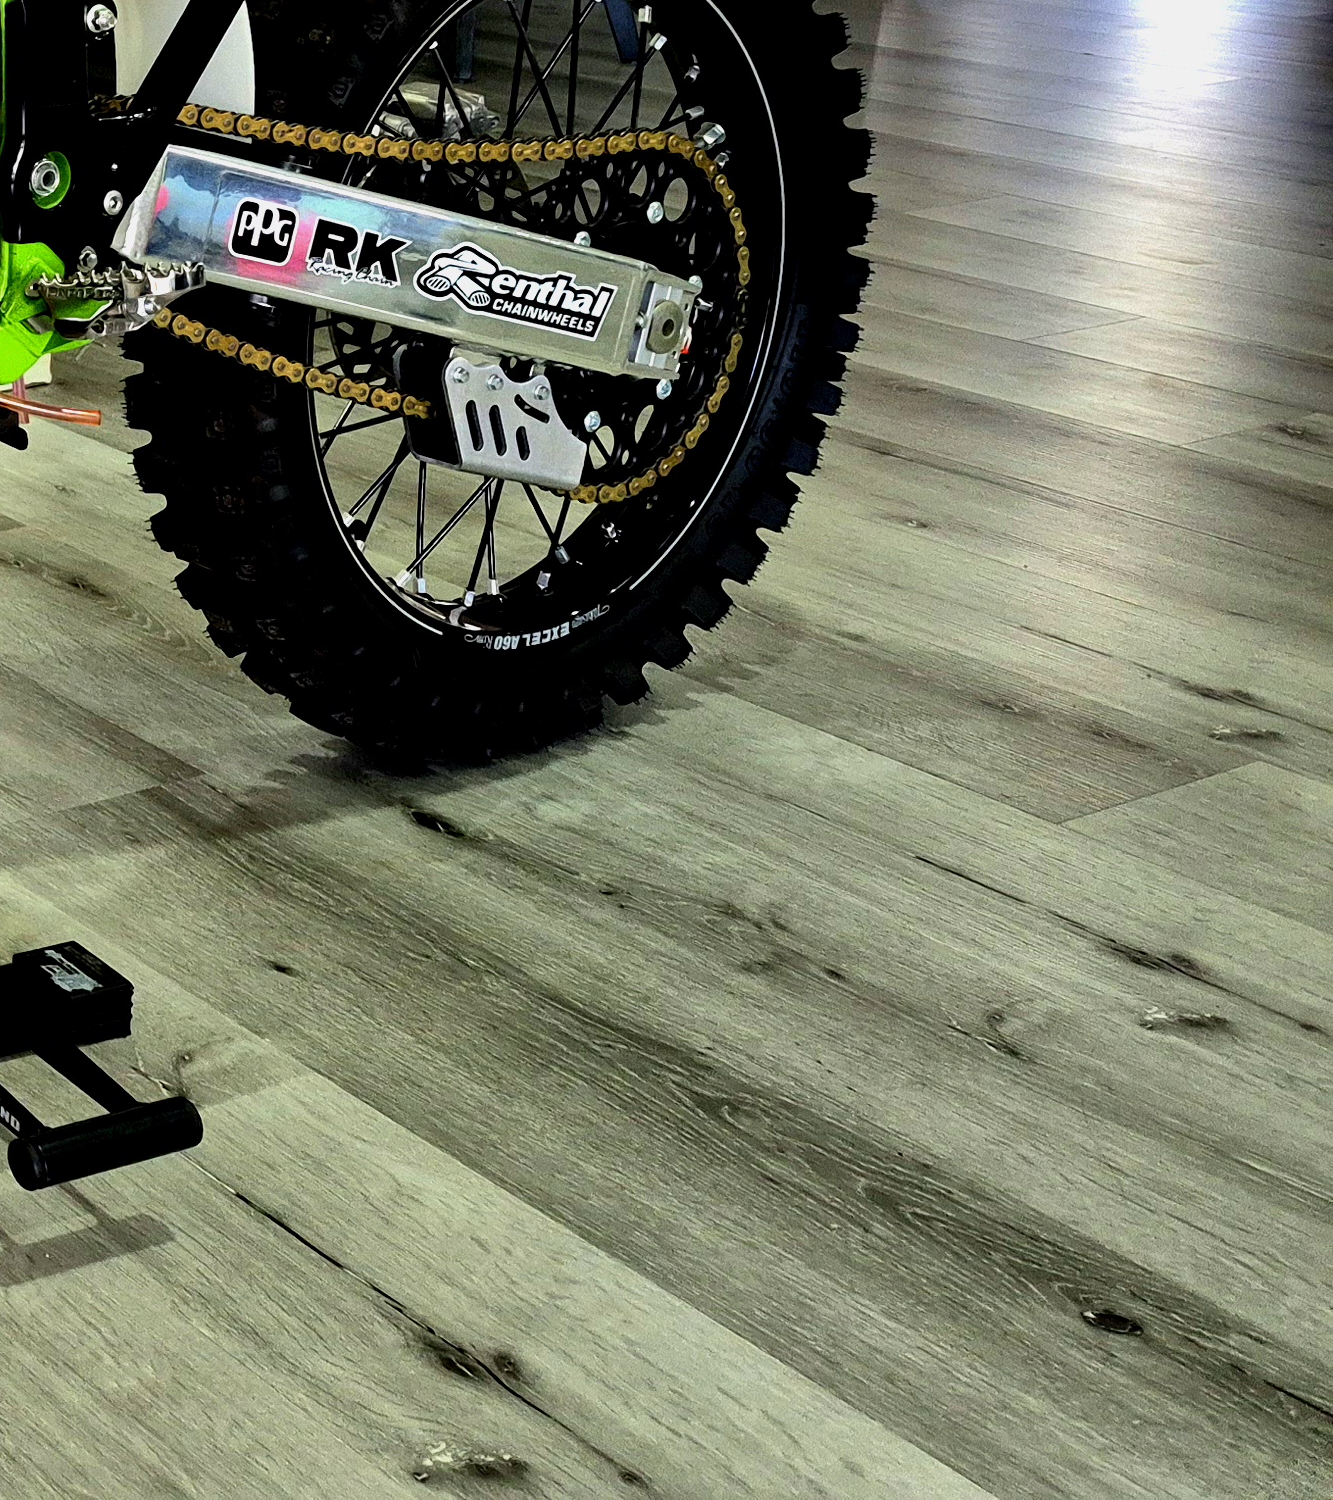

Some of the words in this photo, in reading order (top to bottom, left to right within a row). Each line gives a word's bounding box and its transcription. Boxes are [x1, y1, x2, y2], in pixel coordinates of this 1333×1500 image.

[309, 218, 408, 282] RK
[426, 249, 610, 318] Renthal
[492, 298, 595, 332] CHAINWHEELS
[493, 635, 520, 650] A60
[522, 621, 570, 647] EXCEL
